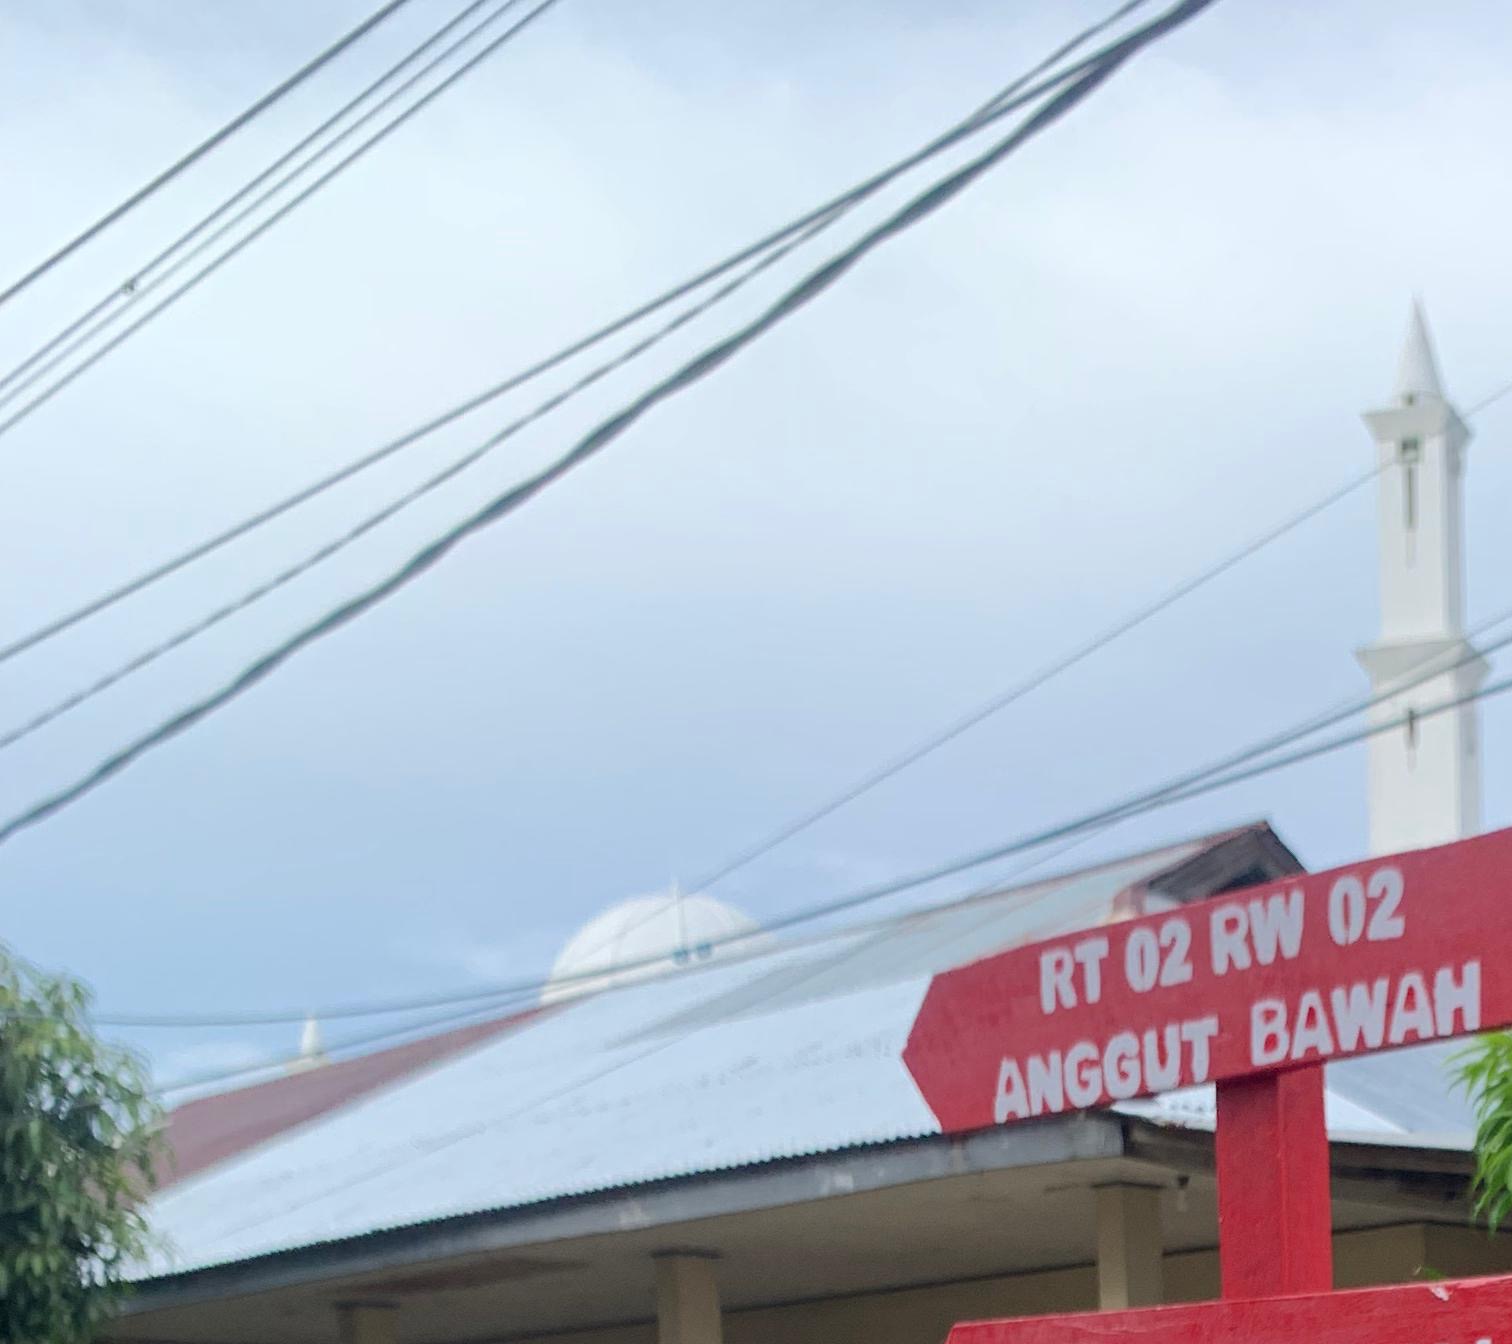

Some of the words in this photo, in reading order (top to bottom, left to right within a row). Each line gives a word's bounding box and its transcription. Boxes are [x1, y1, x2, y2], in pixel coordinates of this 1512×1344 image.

[1040, 938, 1109, 1013] RT
[1126, 917, 1193, 991] 02
[1211, 889, 1305, 975] RW
[1329, 867, 1405, 944] 02
[994, 1017, 1218, 1124] ANGGUT
[1251, 961, 1481, 1066] BAWAH
